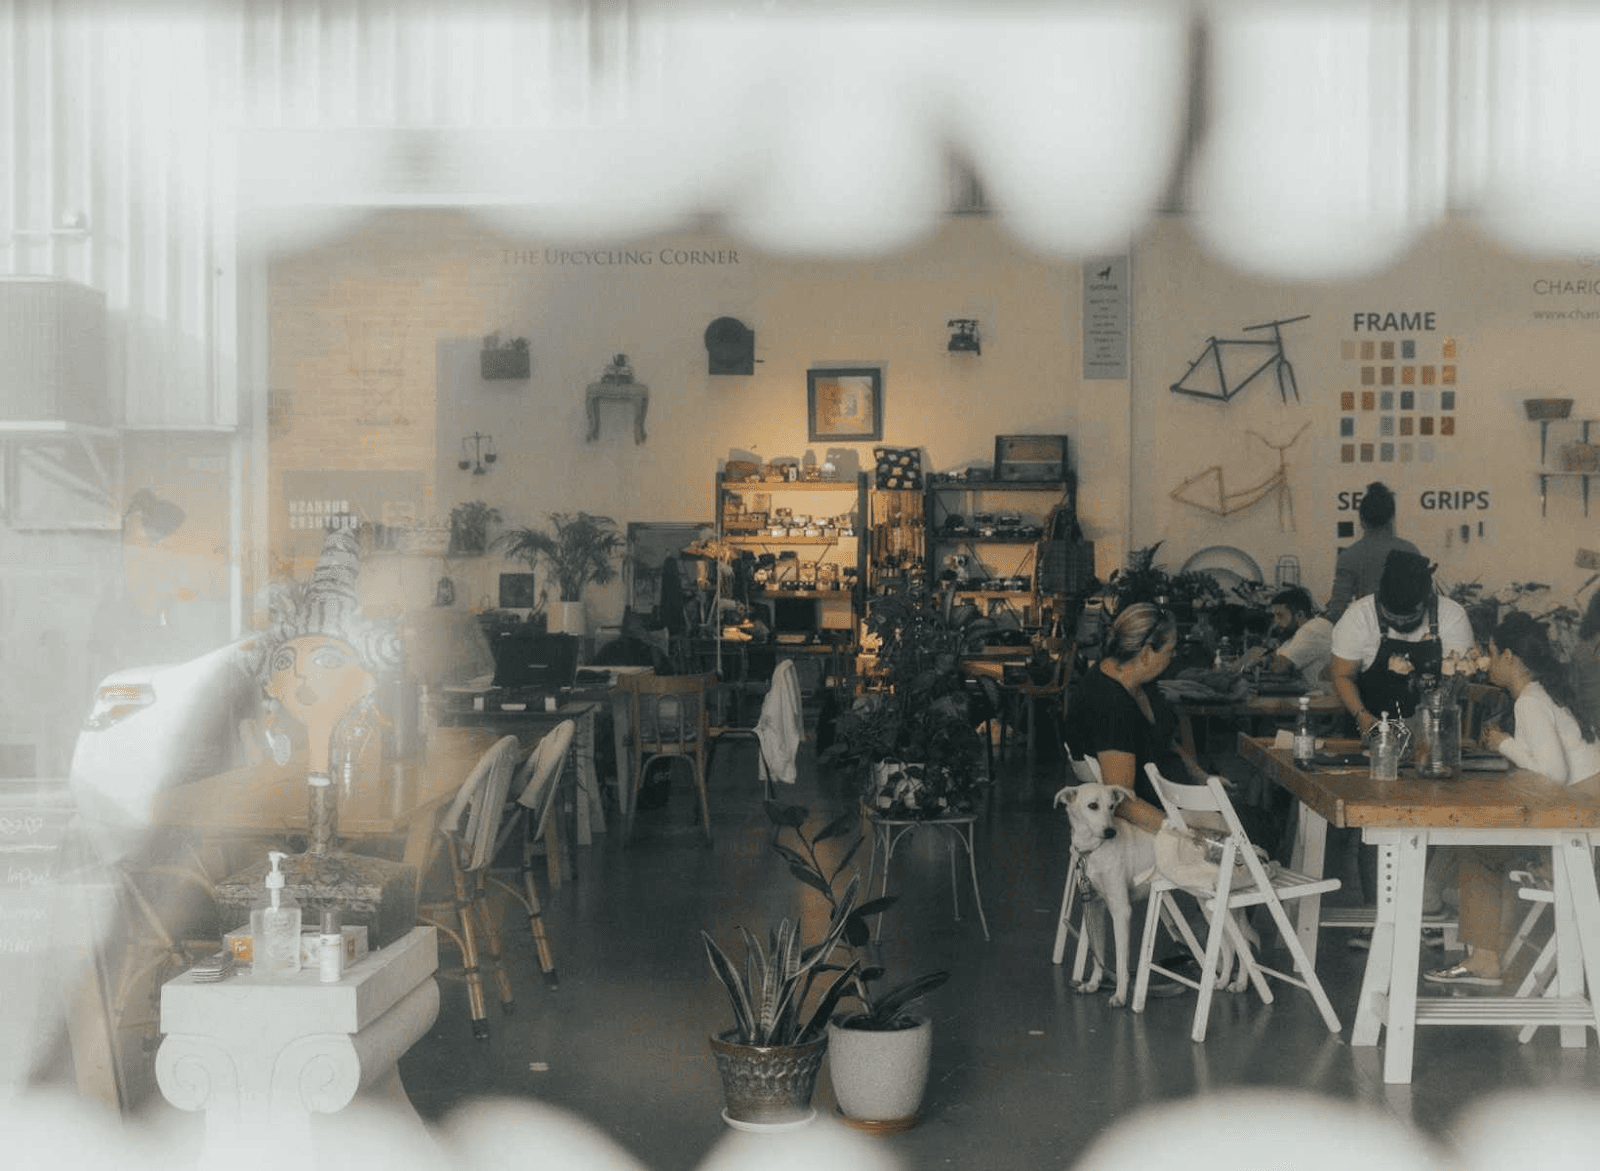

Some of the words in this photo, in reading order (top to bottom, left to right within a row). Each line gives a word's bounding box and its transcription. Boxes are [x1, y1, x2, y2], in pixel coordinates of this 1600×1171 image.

[659, 249, 740, 266] CORNER
[1353, 311, 1436, 332] FRAME
[1420, 491, 1490, 510] GRIPS
